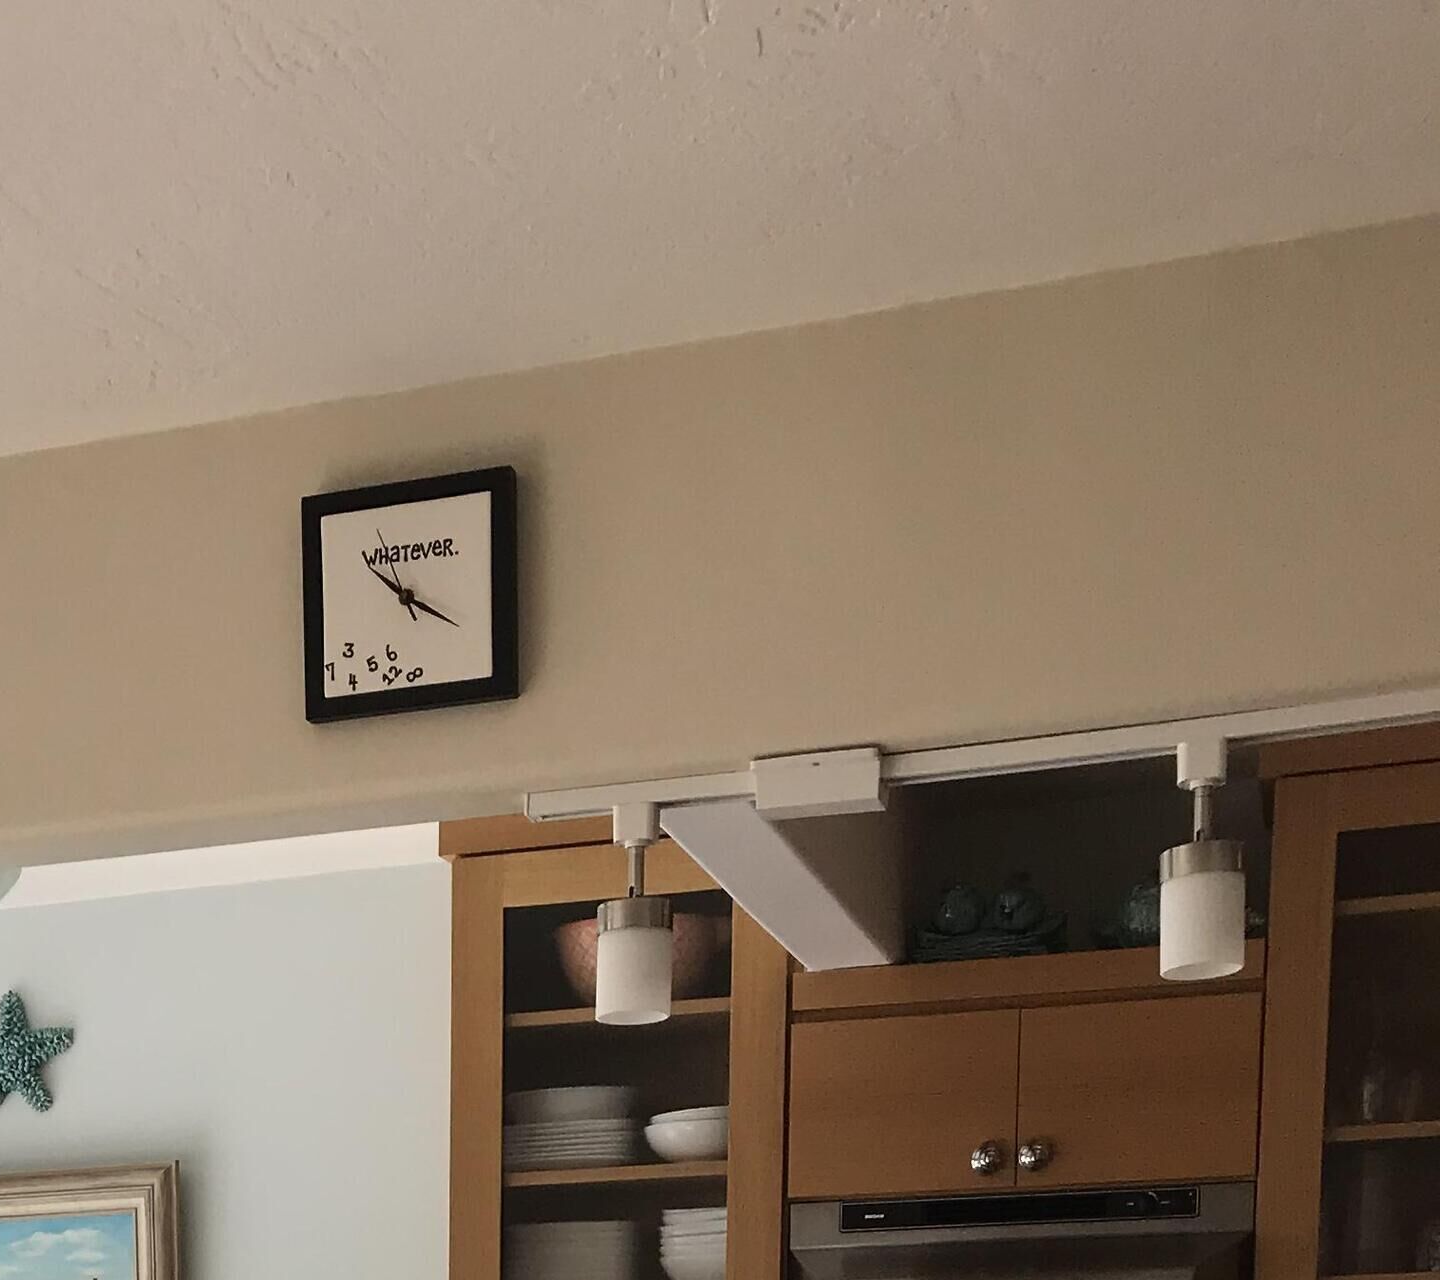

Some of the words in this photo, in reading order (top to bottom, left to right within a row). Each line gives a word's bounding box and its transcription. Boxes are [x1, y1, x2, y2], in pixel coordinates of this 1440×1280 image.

[342, 642, 354, 658] 3
[385, 644, 398, 661] 6
[325, 662, 335, 681] 7
[366, 655, 379, 672] 5
[348, 673, 358, 691] 4
[382, 666, 402, 686] 12
[406, 667, 423, 683] 8
